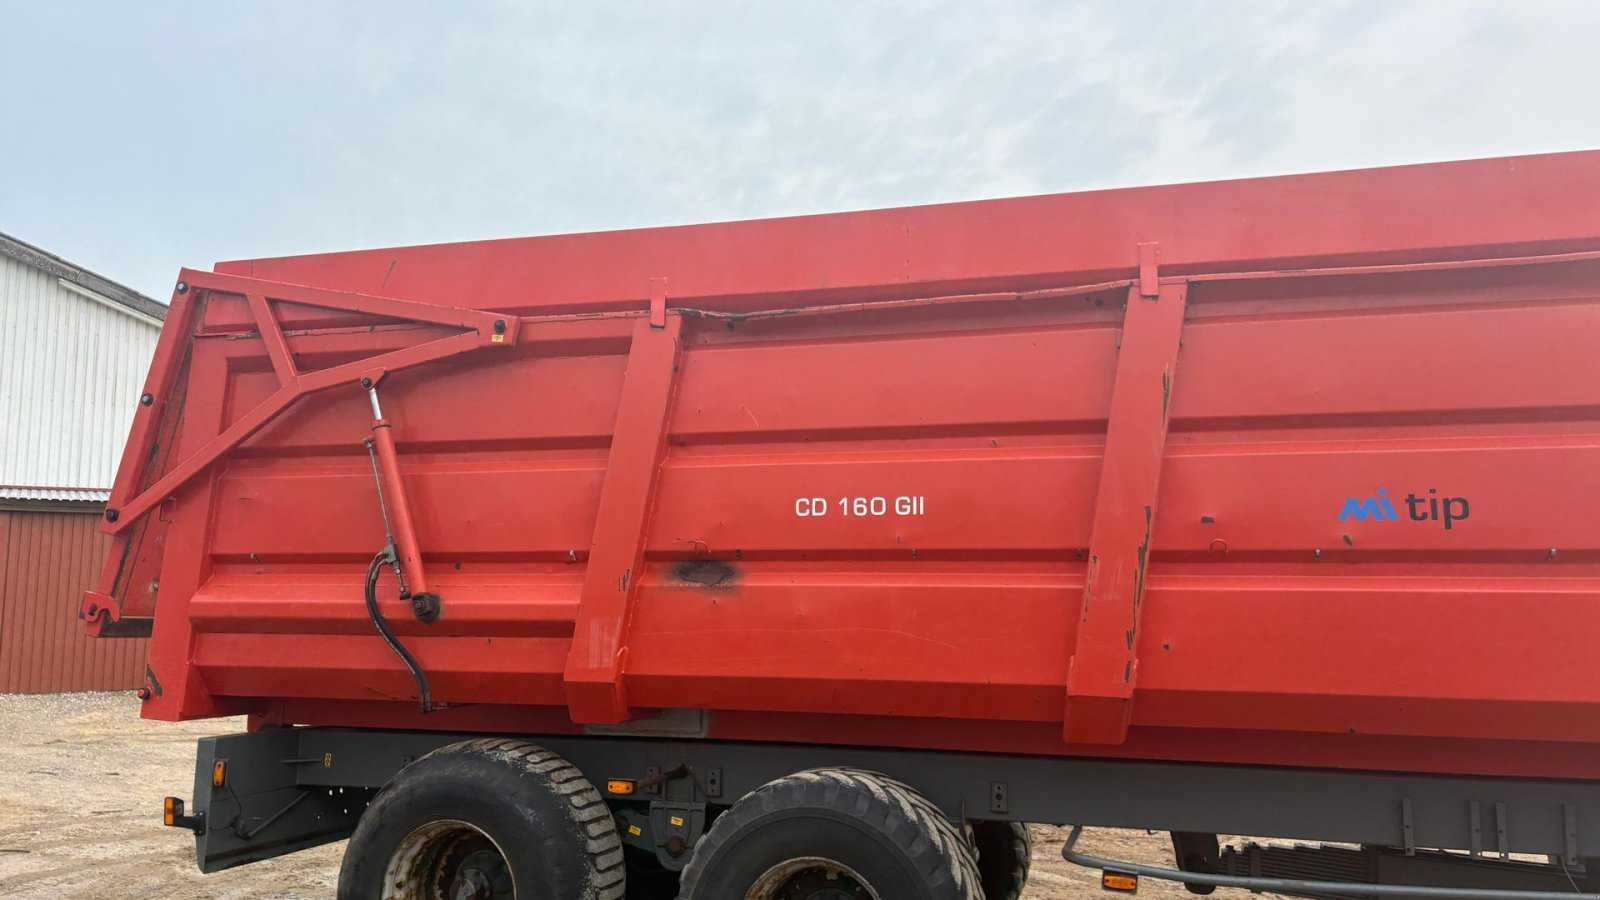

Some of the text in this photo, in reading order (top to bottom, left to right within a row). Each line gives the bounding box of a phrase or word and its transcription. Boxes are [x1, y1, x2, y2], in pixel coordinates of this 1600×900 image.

[795, 495, 925, 517] CD 160 GII
[1405, 488, 1470, 530] tip
